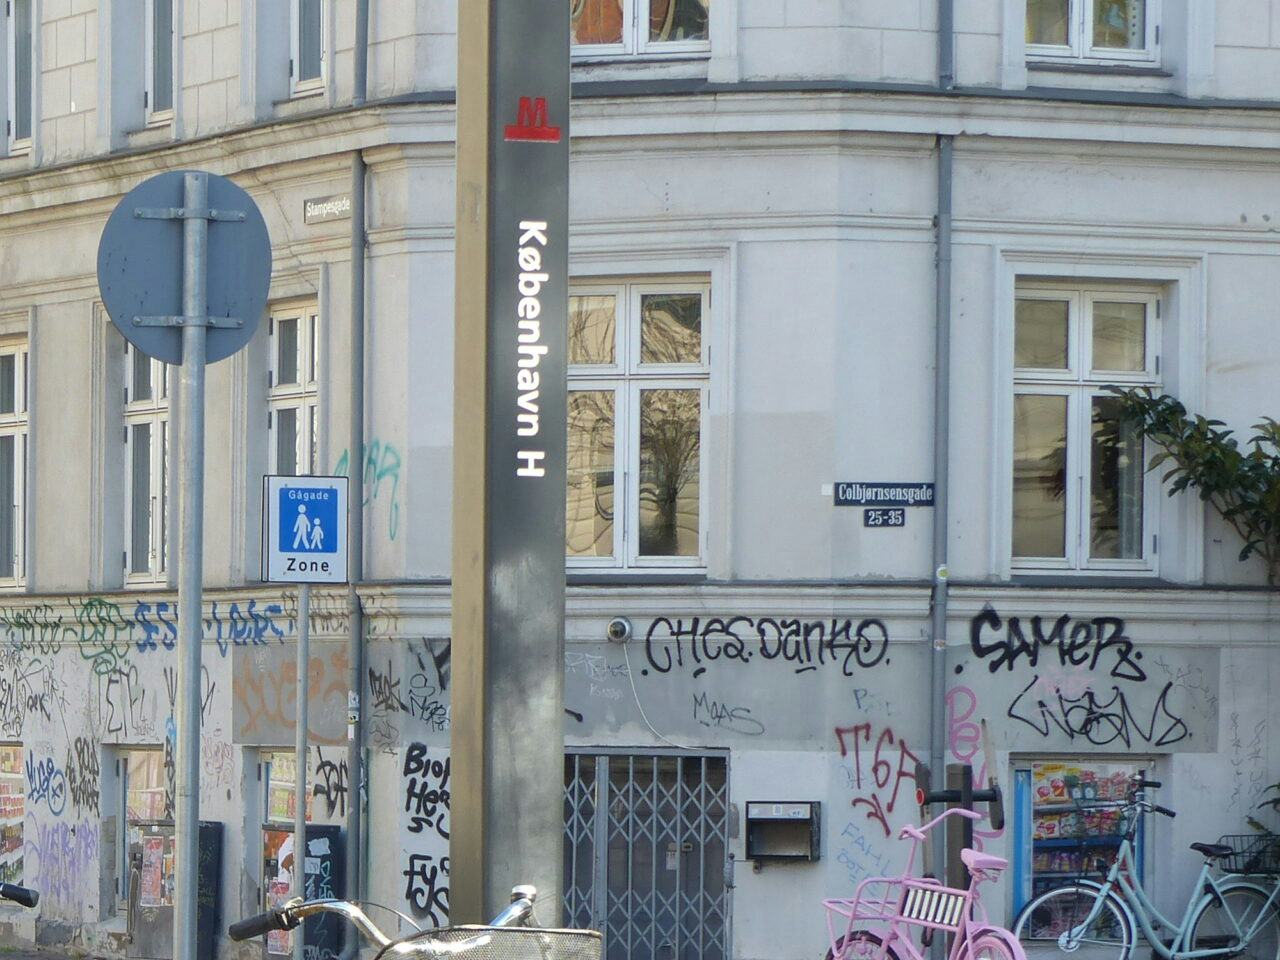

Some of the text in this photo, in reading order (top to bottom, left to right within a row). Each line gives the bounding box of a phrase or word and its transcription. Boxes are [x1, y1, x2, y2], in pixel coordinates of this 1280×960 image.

[517, 220, 548, 477] København H
[288, 490, 329, 501] Gågade
[838, 483, 933, 504] Colbjørnsensgade
[868, 510, 902, 525] 25-35
[287, 558, 329, 571] Zone
